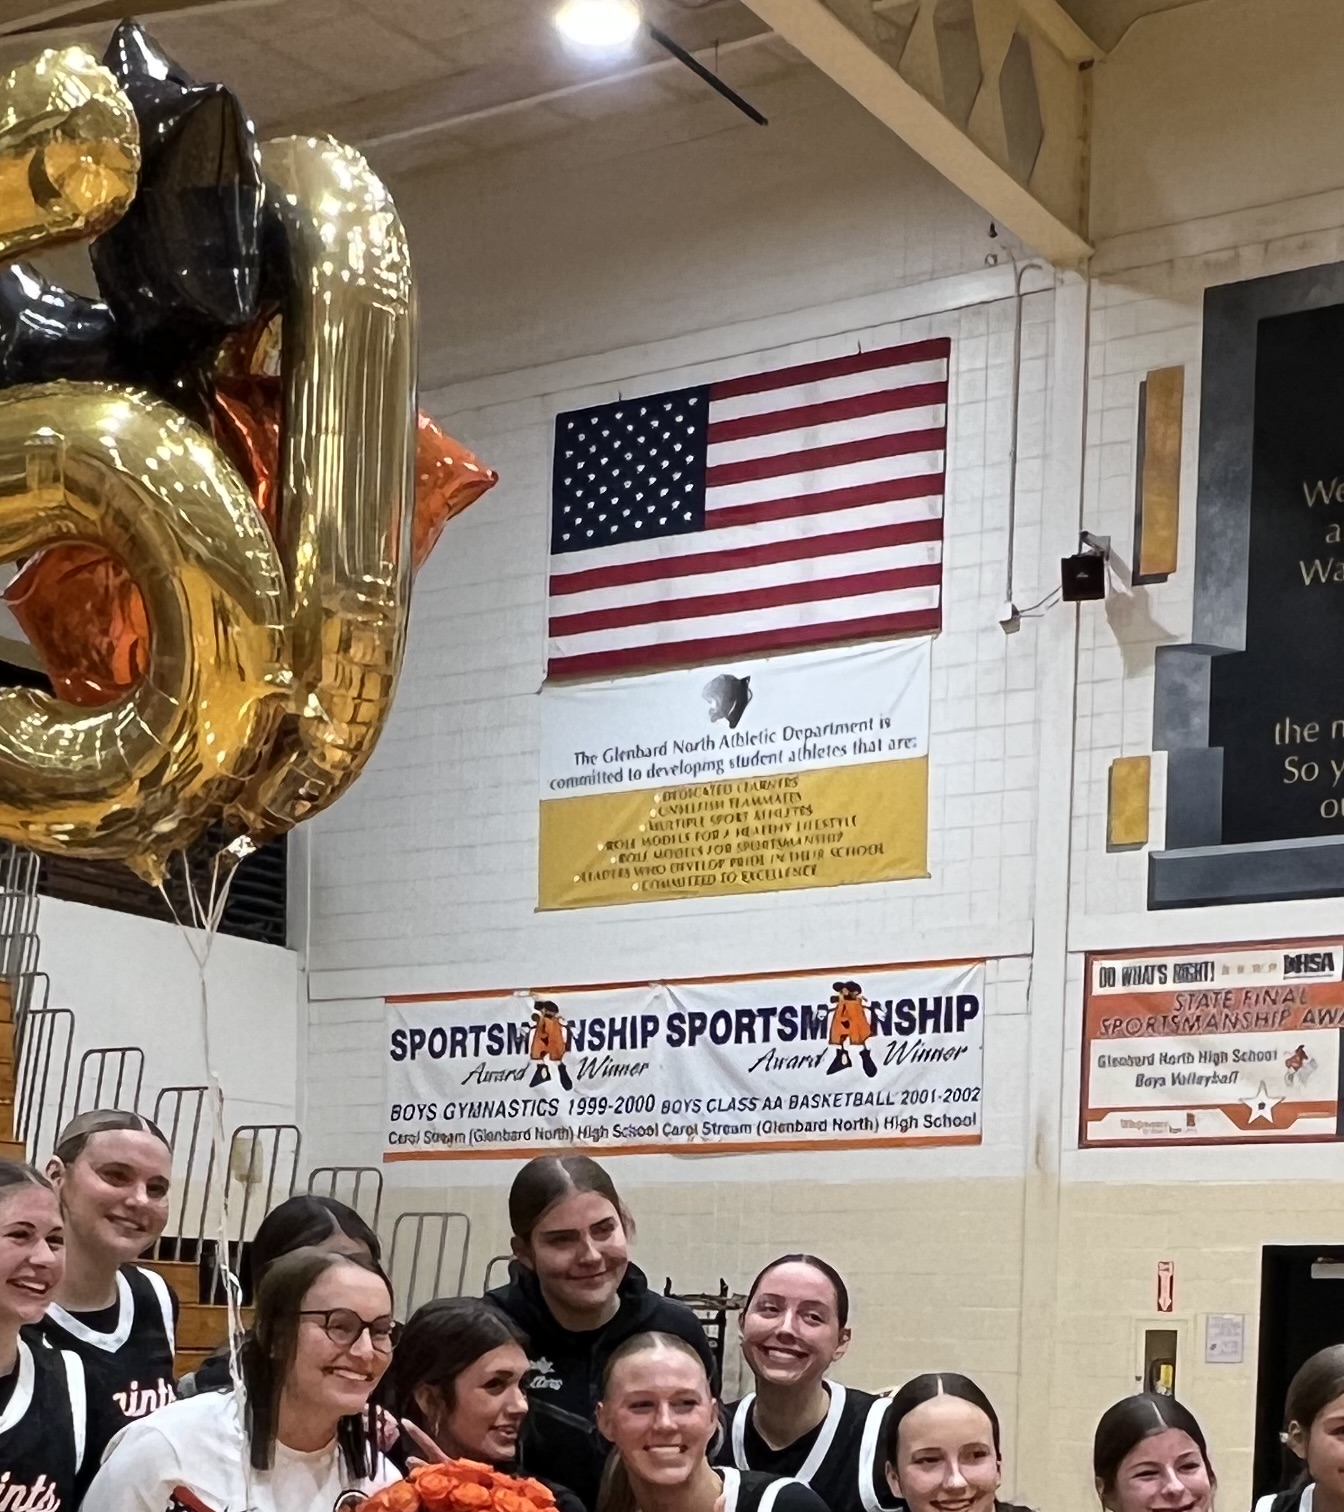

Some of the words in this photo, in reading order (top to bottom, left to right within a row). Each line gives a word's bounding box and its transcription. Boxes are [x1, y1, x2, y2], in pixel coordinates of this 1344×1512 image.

[574, 750, 598, 768] The
[602, 740, 668, 765] Glenbard
[672, 733, 716, 756] North
[718, 727, 778, 751] Athletic
[782, 717, 874, 747] Department
[879, 715, 892, 730] is
[1275, 717, 1319, 745] the
[549, 767, 624, 791] committed
[628, 763, 643, 782] to
[646, 752, 725, 779] developing
[728, 748, 784, 770] student
[787, 739, 848, 765] athletes
[851, 737, 883, 756] that
[1284, 756, 1319, 783] So
[1173, 990, 1233, 1013] STATE
[1242, 986, 1309, 1008] FINAL
[389, 1012, 660, 1063] SPORTSMANSHIP
[666, 994, 980, 1049] SPORTSMANSHIP
[1100, 1009, 1292, 1038] SPORTSMANSHIP
[461, 1061, 532, 1086] Award
[576, 1055, 650, 1082] Winner
[748, 1047, 829, 1073] Award
[883, 1039, 968, 1066] Winner
[390, 1102, 437, 1122] BOYS
[443, 1098, 559, 1120] GYMNASTICS
[567, 1093, 656, 1116] 1999-2000
[661, 1097, 702, 1115] BOYS
[706, 1094, 757, 1113] CLASS
[762, 1093, 783, 1112] AA
[788, 1090, 895, 1111] BASKETBALL
[900, 1086, 982, 1106] 2001-2002
[662, 1120, 699, 1137] Carol
[702, 1119, 752, 1137] Stream
[756, 1117, 828, 1138] (Glenbard
[832, 1115, 879, 1135] North)
[884, 1114, 919, 1133] High
[923, 1111, 977, 1129] School
